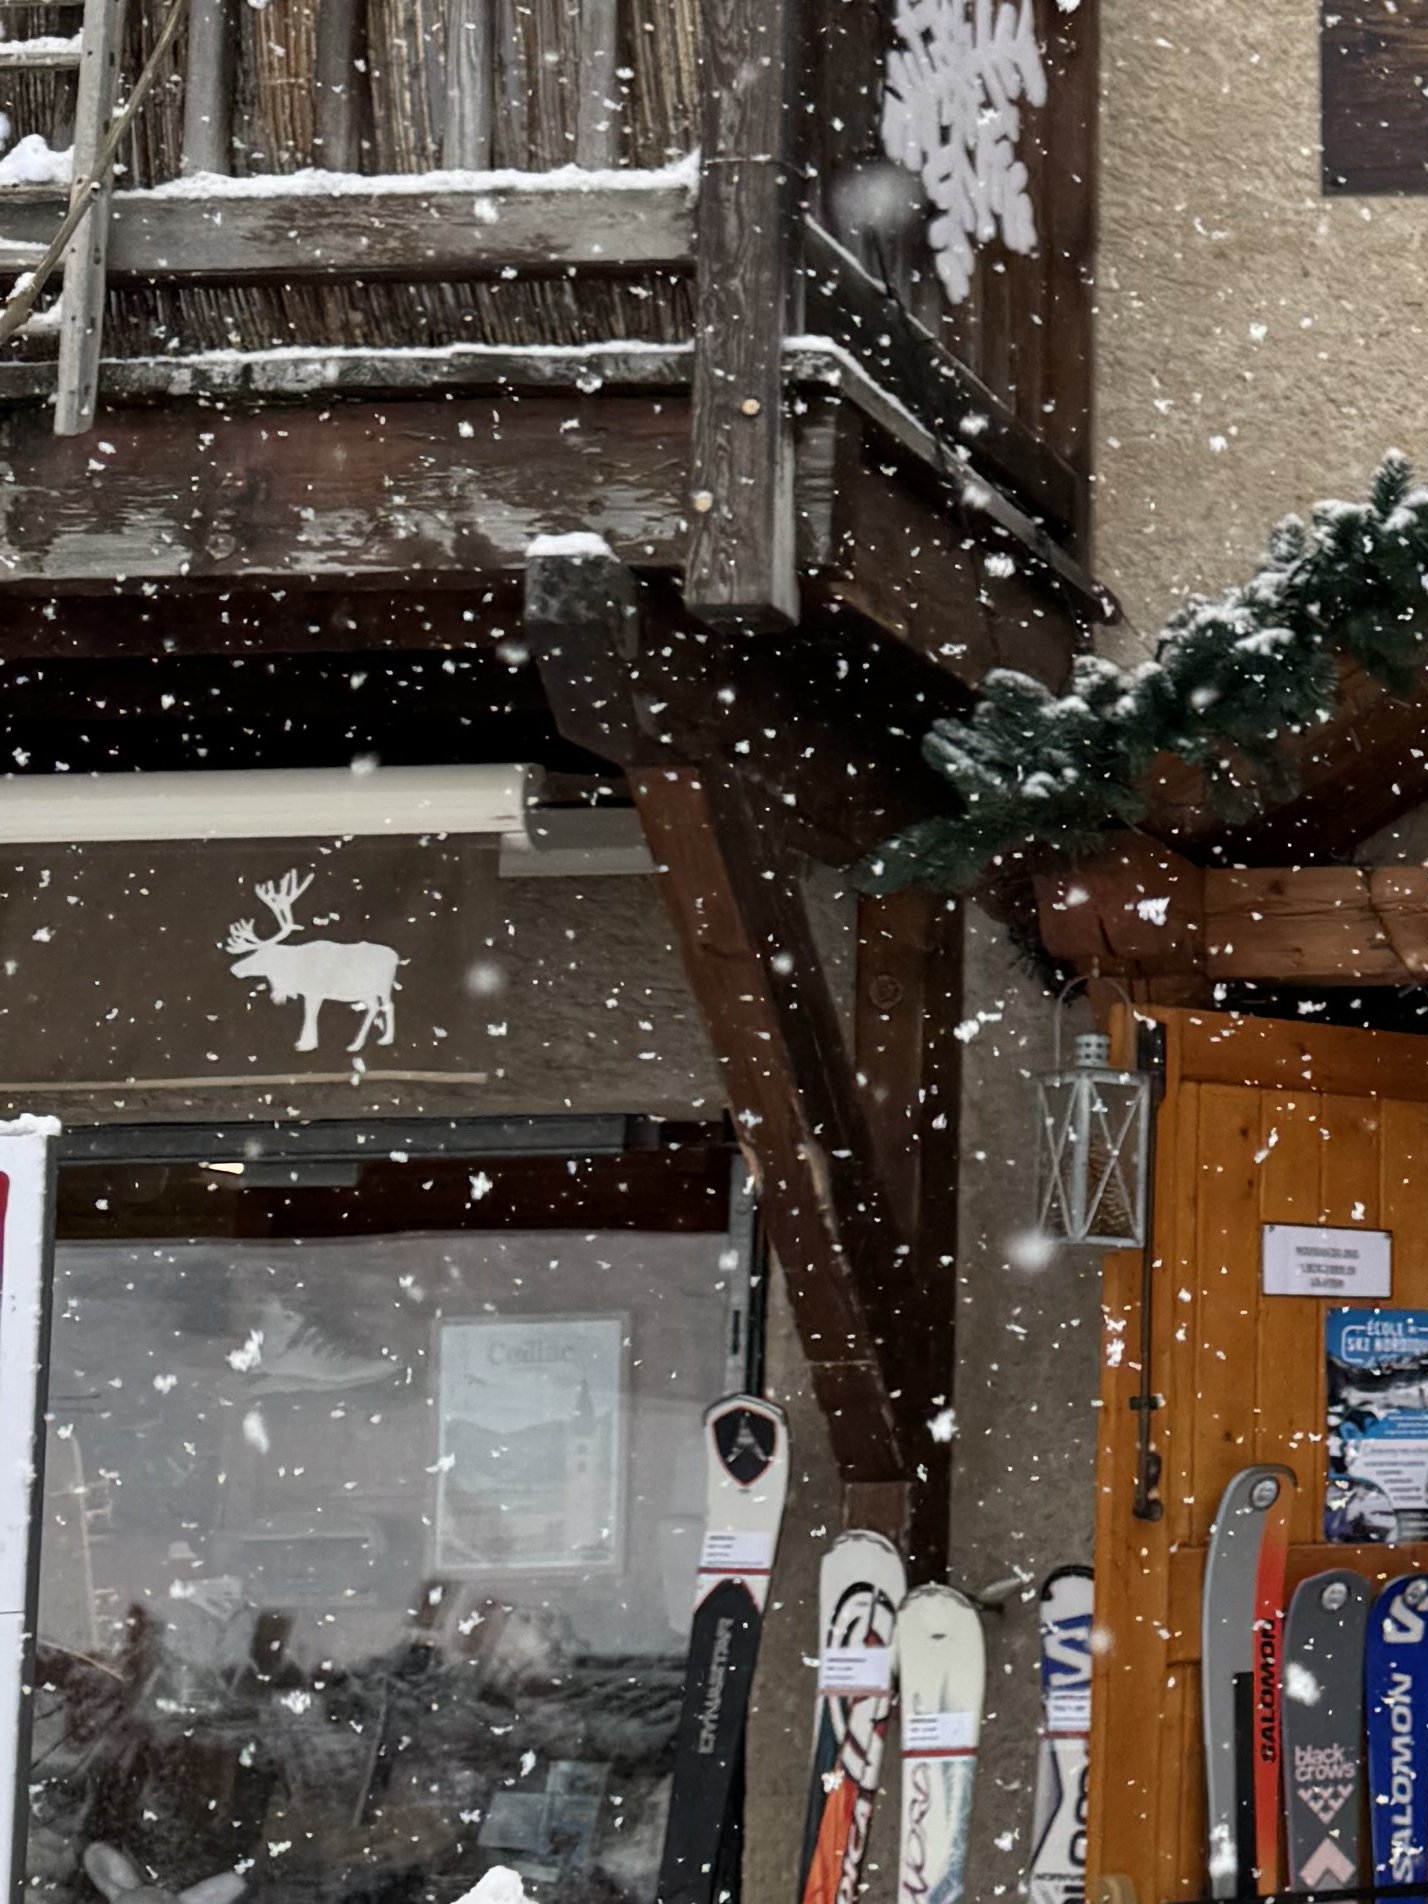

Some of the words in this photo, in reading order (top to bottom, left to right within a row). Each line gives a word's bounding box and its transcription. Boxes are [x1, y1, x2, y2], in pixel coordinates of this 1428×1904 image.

[697, 1616, 735, 1755] DYNASTAR
[1259, 1619, 1277, 1764] SALOMON
[1294, 1743, 1346, 1766] black
[1294, 1761, 1356, 1783] crows
[1389, 1672, 1416, 1884] SALOMON
